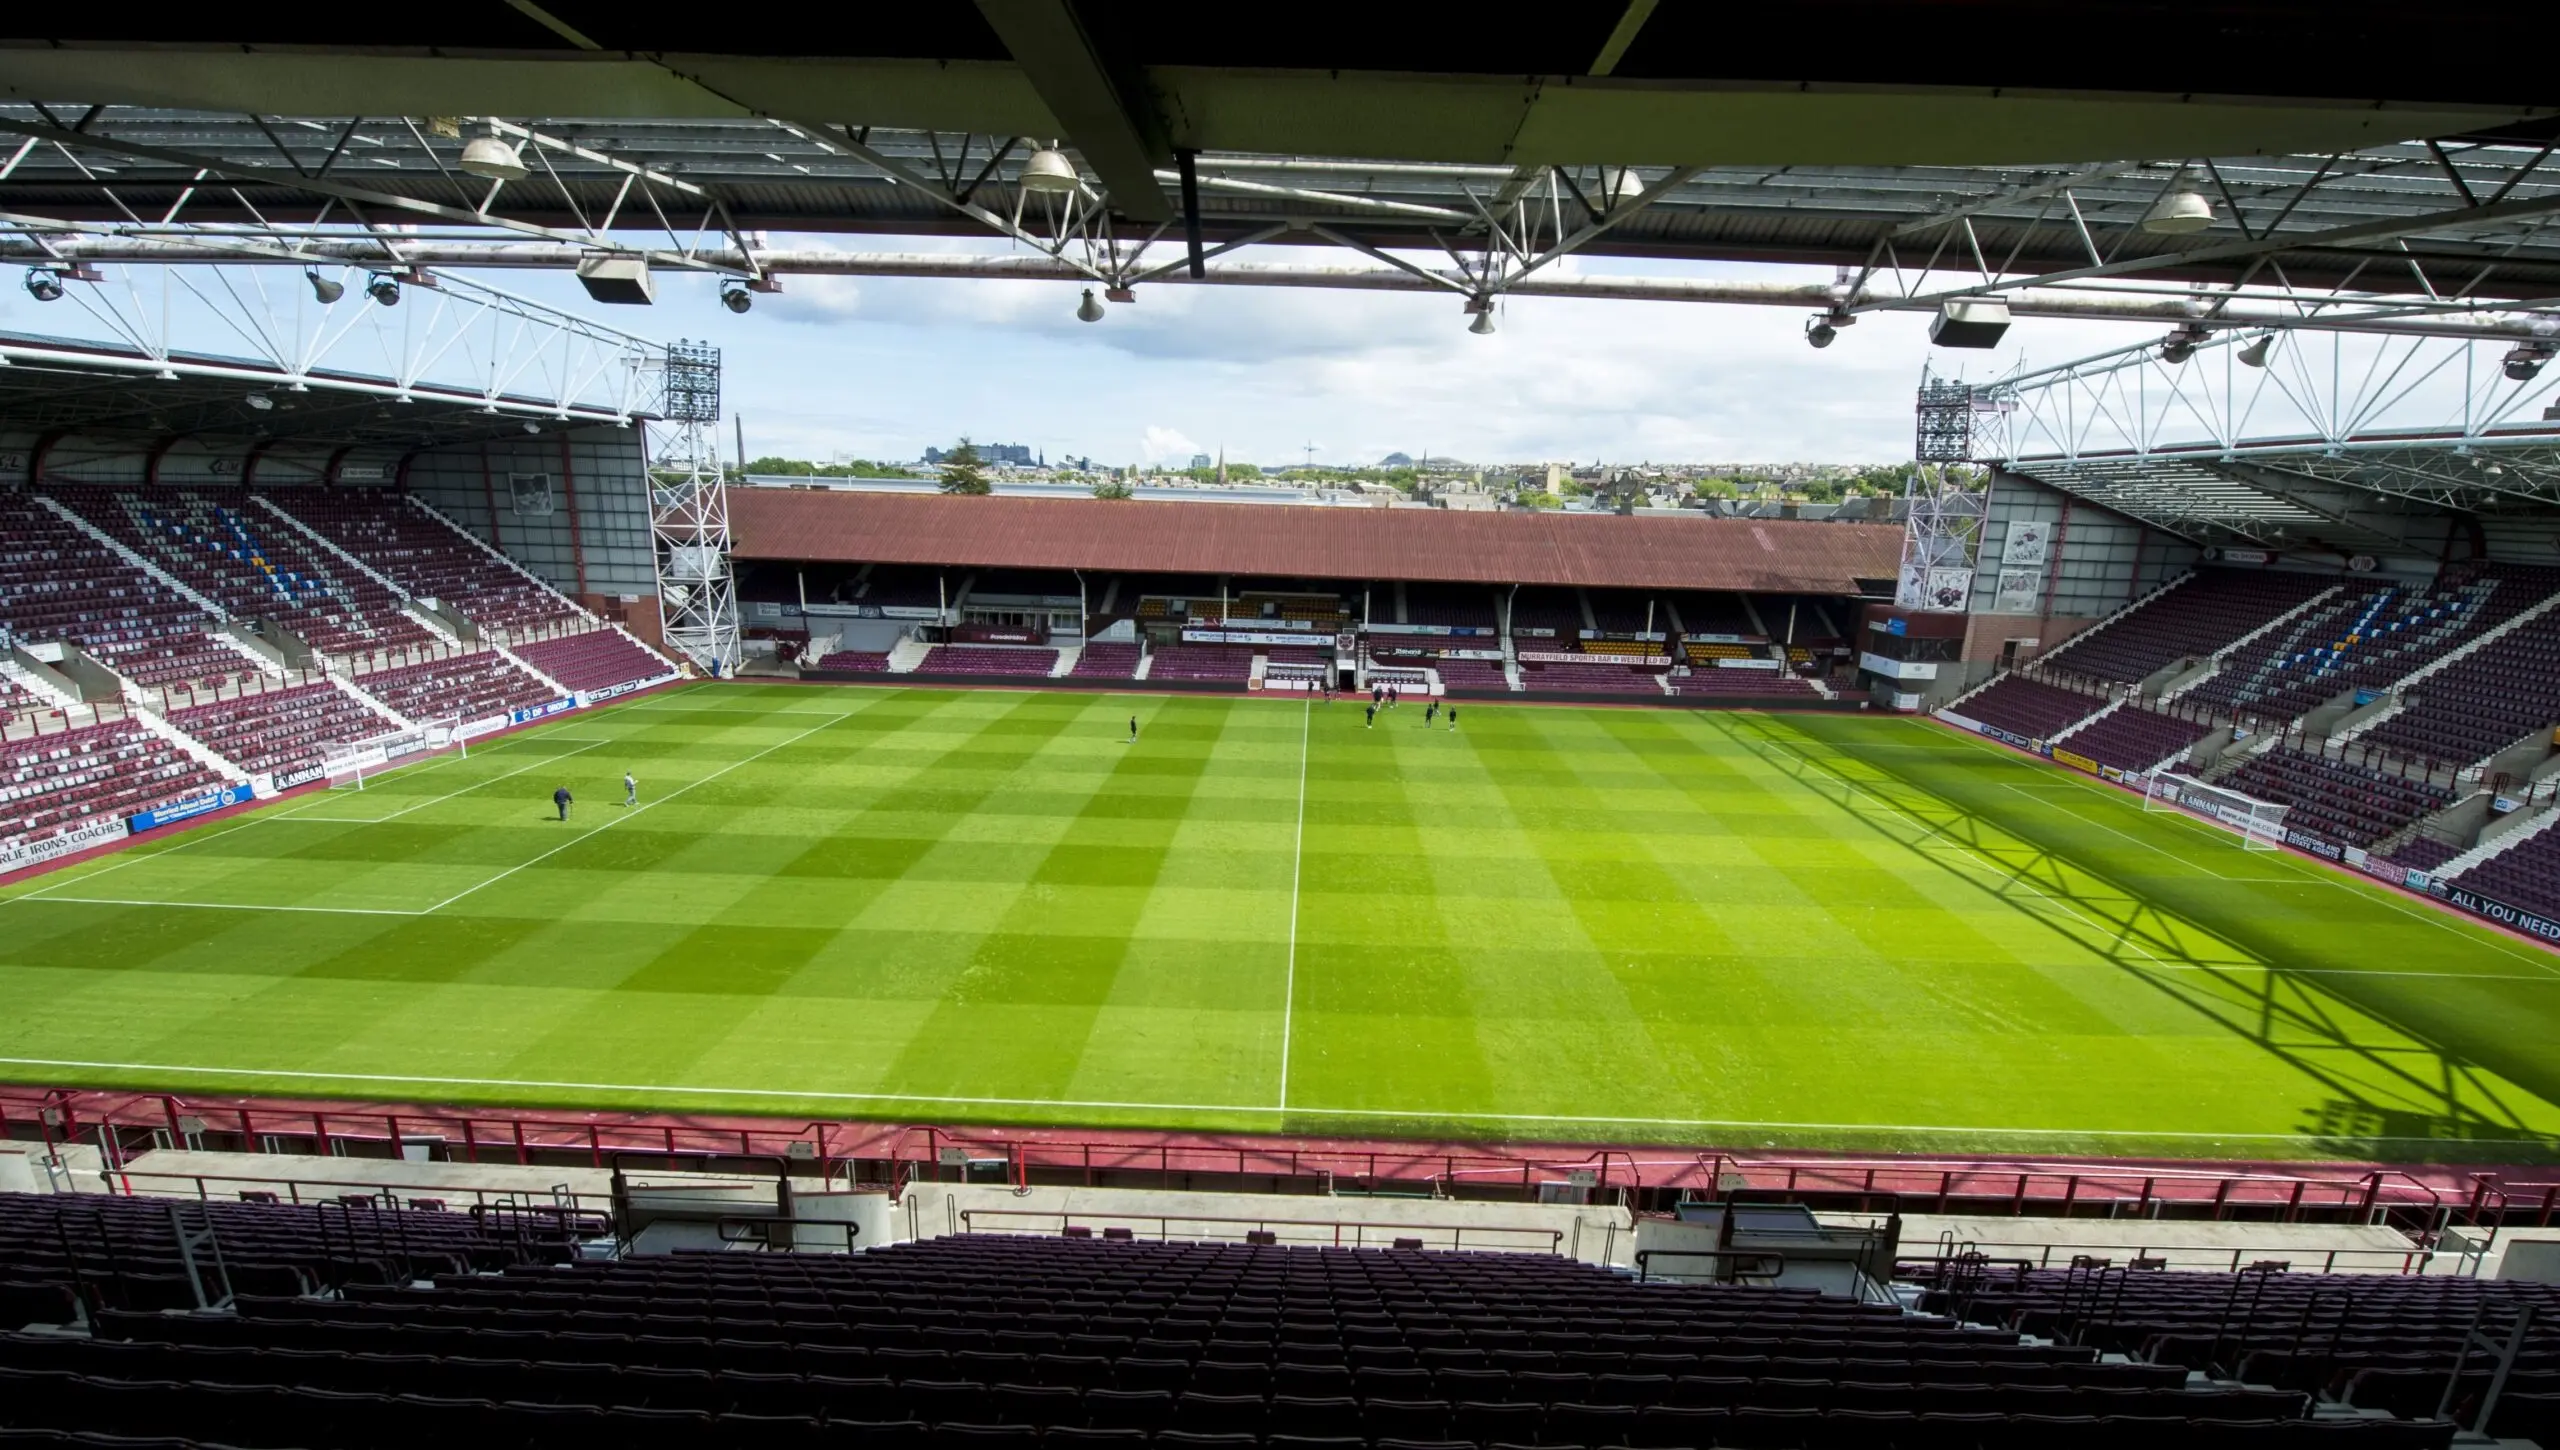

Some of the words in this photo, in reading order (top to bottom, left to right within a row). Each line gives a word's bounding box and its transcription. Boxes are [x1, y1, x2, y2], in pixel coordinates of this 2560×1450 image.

[1520, 653, 1568, 661] MURRAYFIELD
[1570, 654, 1596, 662] SPORTS
[1621, 657, 1658, 665] WESTFLD
[546, 700, 570, 712] GROUP
[288, 766, 323, 786] ANNAN
[2187, 796, 2218, 814] ANNAN
[30, 836, 67, 855] IRONS
[71, 821, 124, 844] COACHES
[2288, 837, 2310, 849] ESTATE
[2312, 846, 2340, 860] AGENTS
[2289, 831, 2326, 848] SOLICITORS
[2326, 844, 2341, 853] AND
[2452, 892, 2476, 910] ALL
[2483, 901, 2516, 922] YOU
[2519, 914, 2560, 938] NEED
